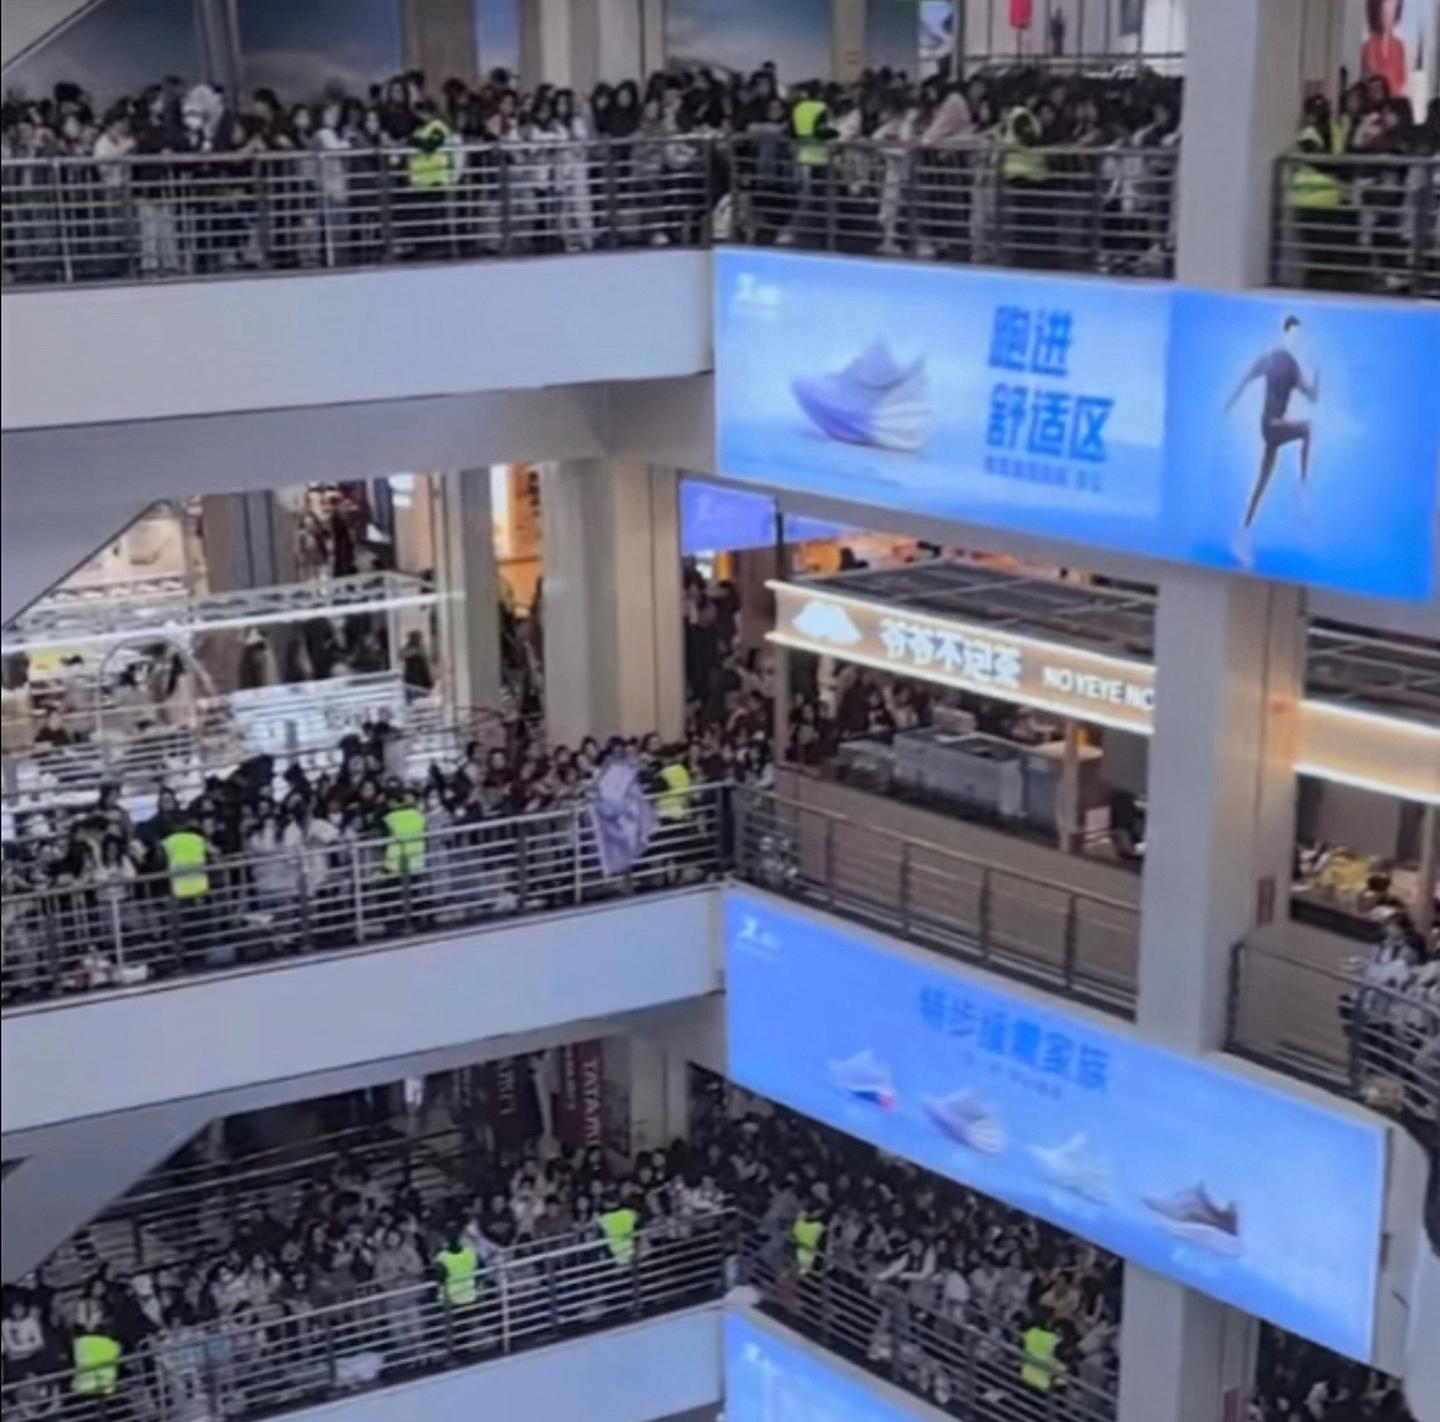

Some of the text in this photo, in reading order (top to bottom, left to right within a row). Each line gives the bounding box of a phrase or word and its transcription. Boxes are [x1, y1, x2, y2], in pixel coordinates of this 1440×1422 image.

[988, 306, 1072, 377] 跑进
[986, 383, 1114, 463] 舒适区
